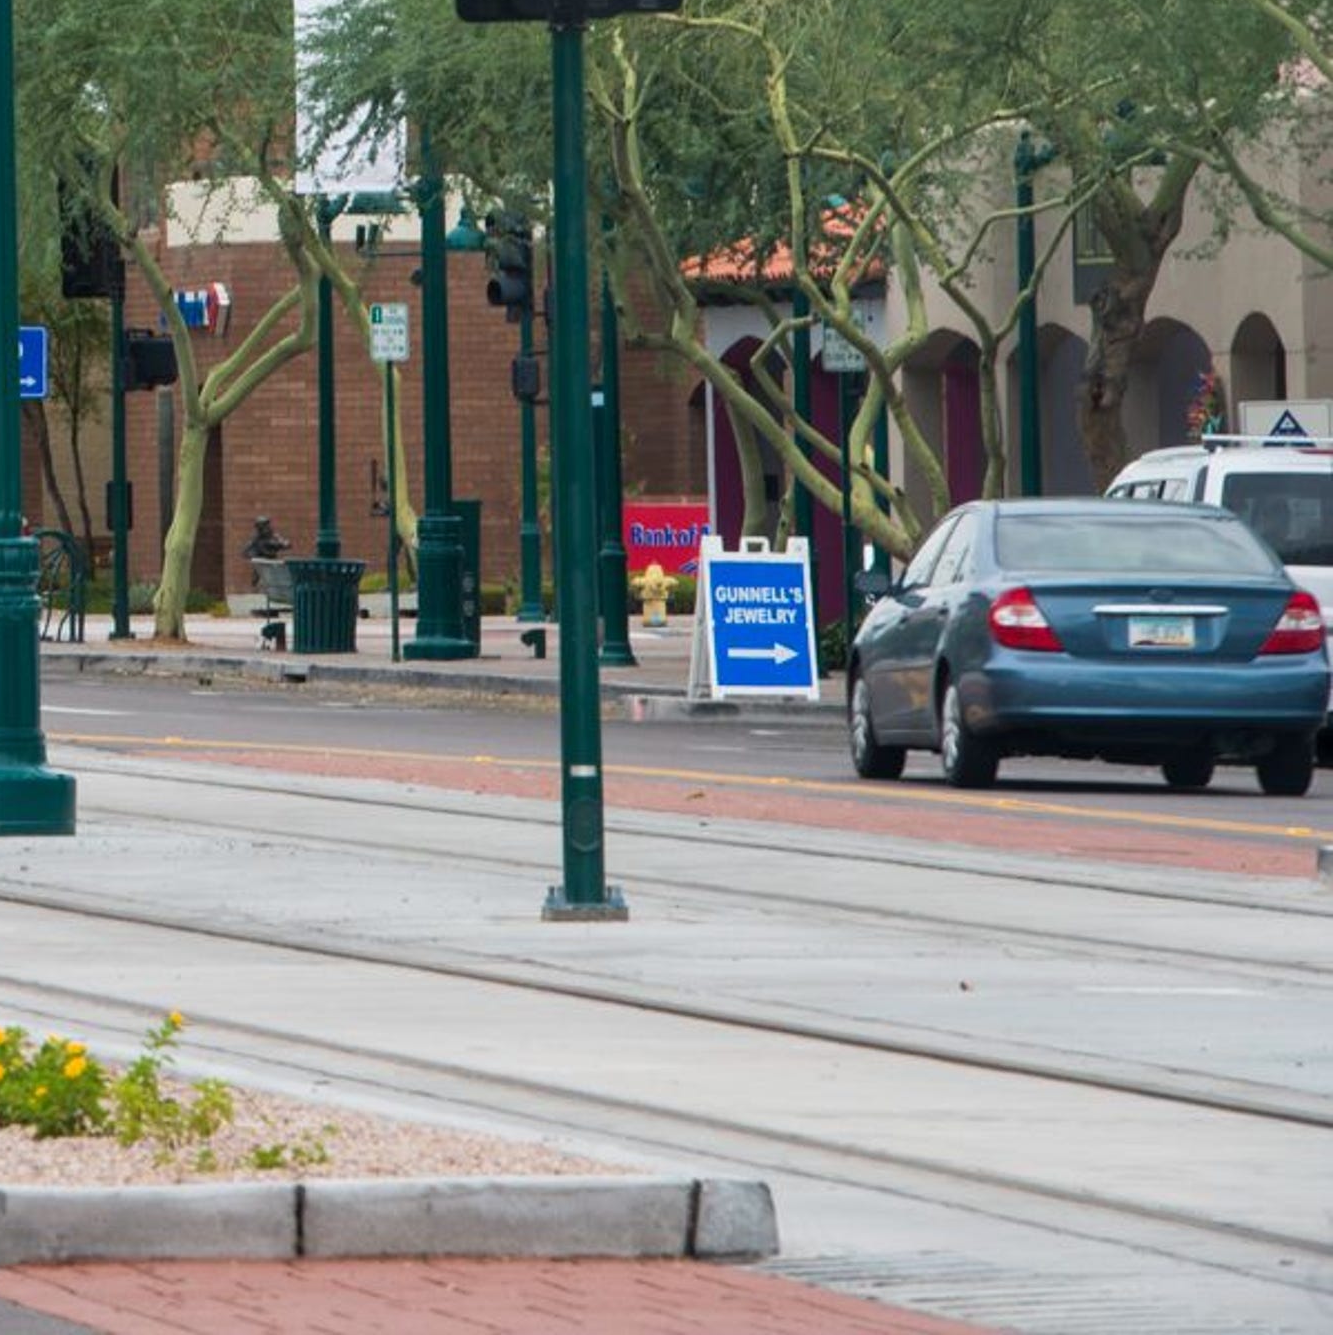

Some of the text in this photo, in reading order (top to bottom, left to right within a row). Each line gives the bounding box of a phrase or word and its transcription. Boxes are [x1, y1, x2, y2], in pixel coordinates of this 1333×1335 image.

[629, 522, 677, 547] Bank
[678, 523, 699, 547] of
[715, 585, 804, 603] GUNNELL'S
[724, 608, 797, 625] JEWELRY
